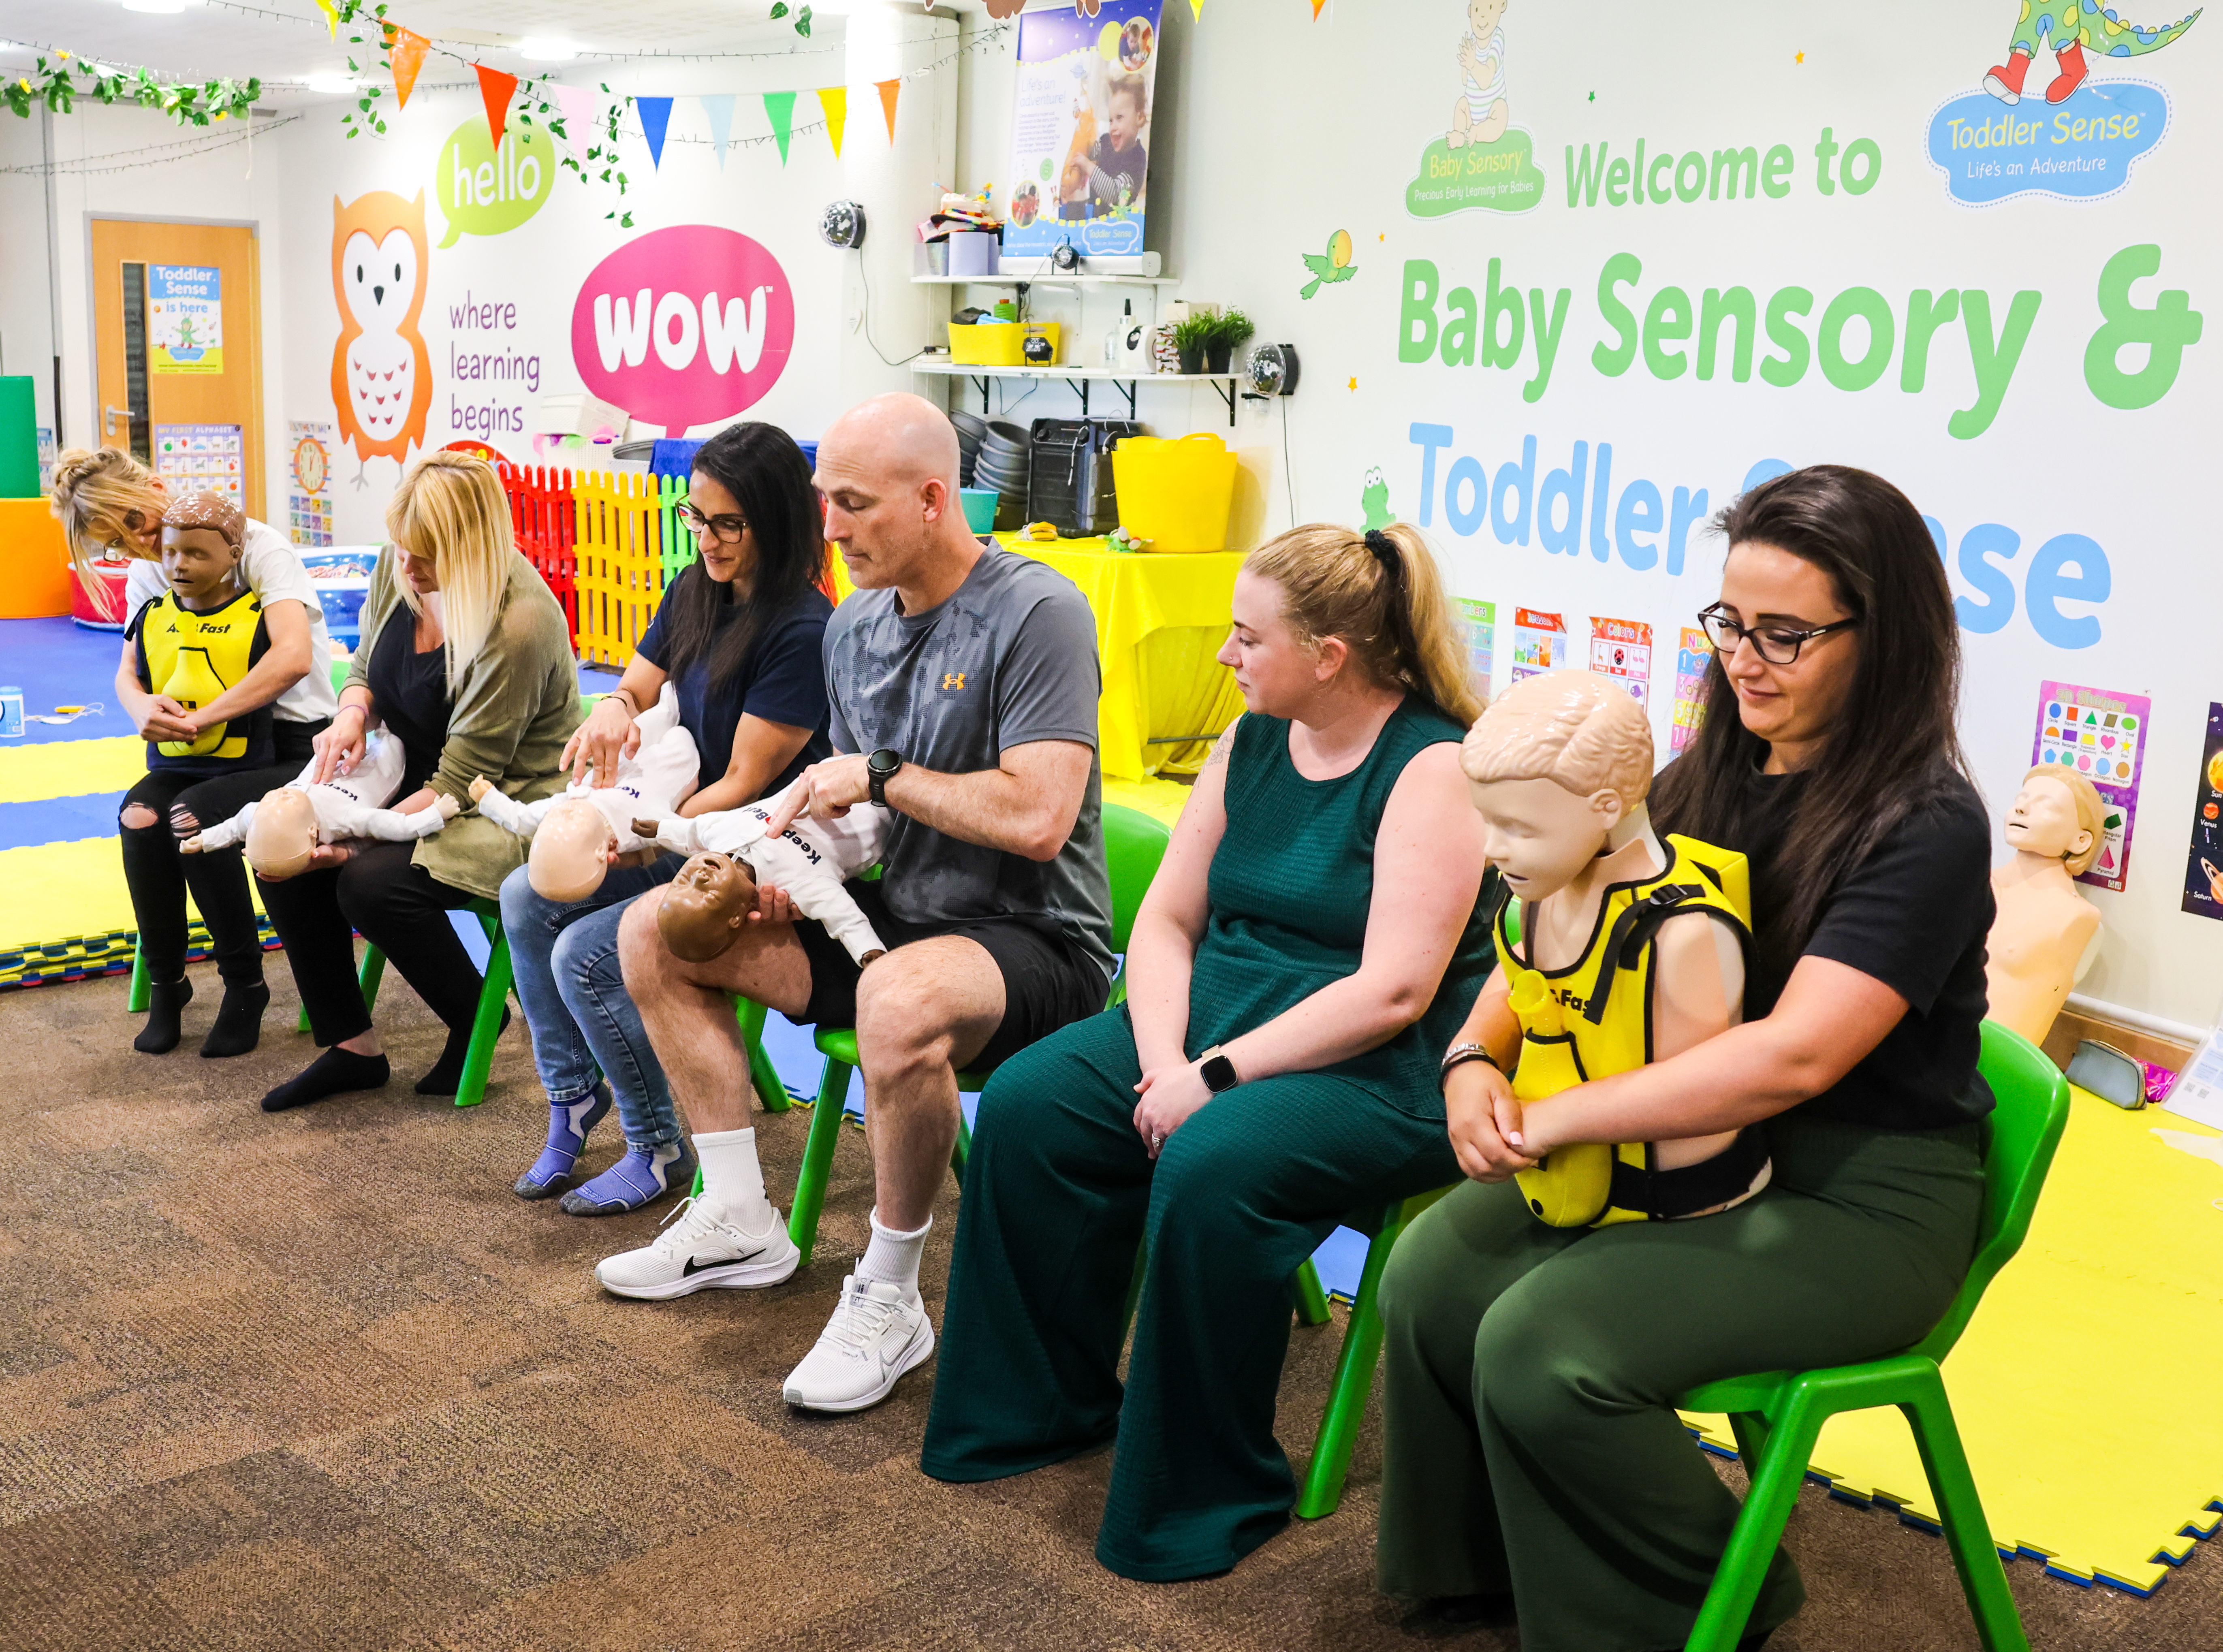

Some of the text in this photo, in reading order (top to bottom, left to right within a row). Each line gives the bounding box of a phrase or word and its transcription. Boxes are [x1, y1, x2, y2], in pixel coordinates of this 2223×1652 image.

[1947, 114, 2043, 150] Toddler
[2050, 111, 2140, 144] Sense
[453, 134, 540, 207] hello
[1430, 151, 1523, 181] Baby Sensory
[1565, 127, 1881, 208] Welcome to
[1967, 156, 2106, 179] Life's an Adventure
[1414, 180, 1534, 201] Precious Early Learning for Babies
[156, 266, 212, 282] Toddler
[166, 280, 208, 295] Sense
[166, 301, 208, 313] is here
[449, 290, 517, 329] where
[1399, 244, 2203, 440] Baby Sensory &
[451, 340, 540, 392] learning
[451, 393, 523, 442] begins
[1409, 422, 1709, 576] Toddler
[1461, 602, 1486, 617] umbers
[199, 623, 231, 634] Fast
[1608, 621, 1635, 639] Colors
[2056, 689, 2127, 713] 2D Shapes
[2211, 790, 2222, 798] Sun
[2200, 818, 2218, 828] Venus
[781, 830, 822, 865] Keep
[2194, 890, 2212, 902] Saturn
